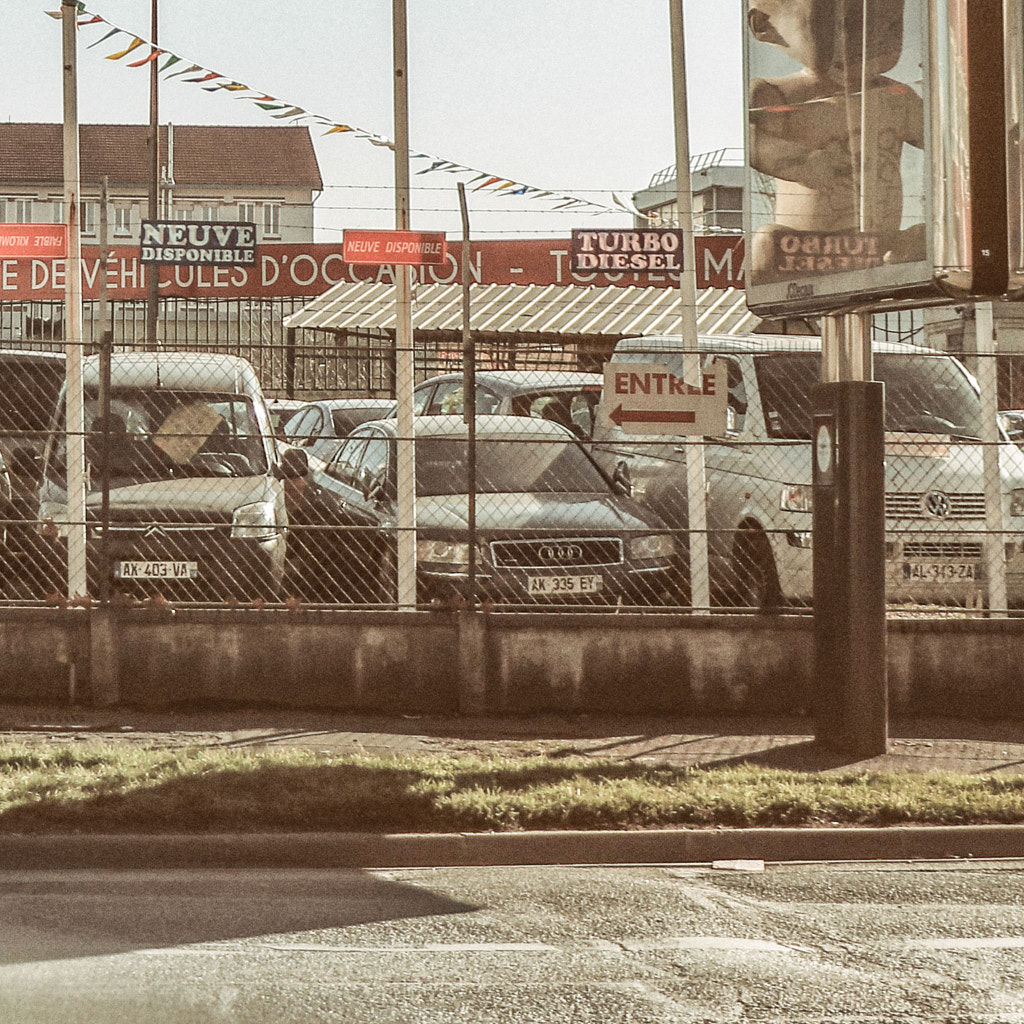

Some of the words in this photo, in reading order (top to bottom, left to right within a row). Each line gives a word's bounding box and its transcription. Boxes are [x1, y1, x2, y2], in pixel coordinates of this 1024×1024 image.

[34, 235, 63, 247] FAIBLE
[142, 224, 255, 247] NEUVE
[577, 232, 679, 252] TURBO
[141, 247, 255, 263] DISPONIBLE
[347, 240, 381, 253] NEUVE
[385, 241, 442, 255] DISPONIBLE
[576, 253, 681, 270] DIESEL
[31, 259, 66, 290] DE
